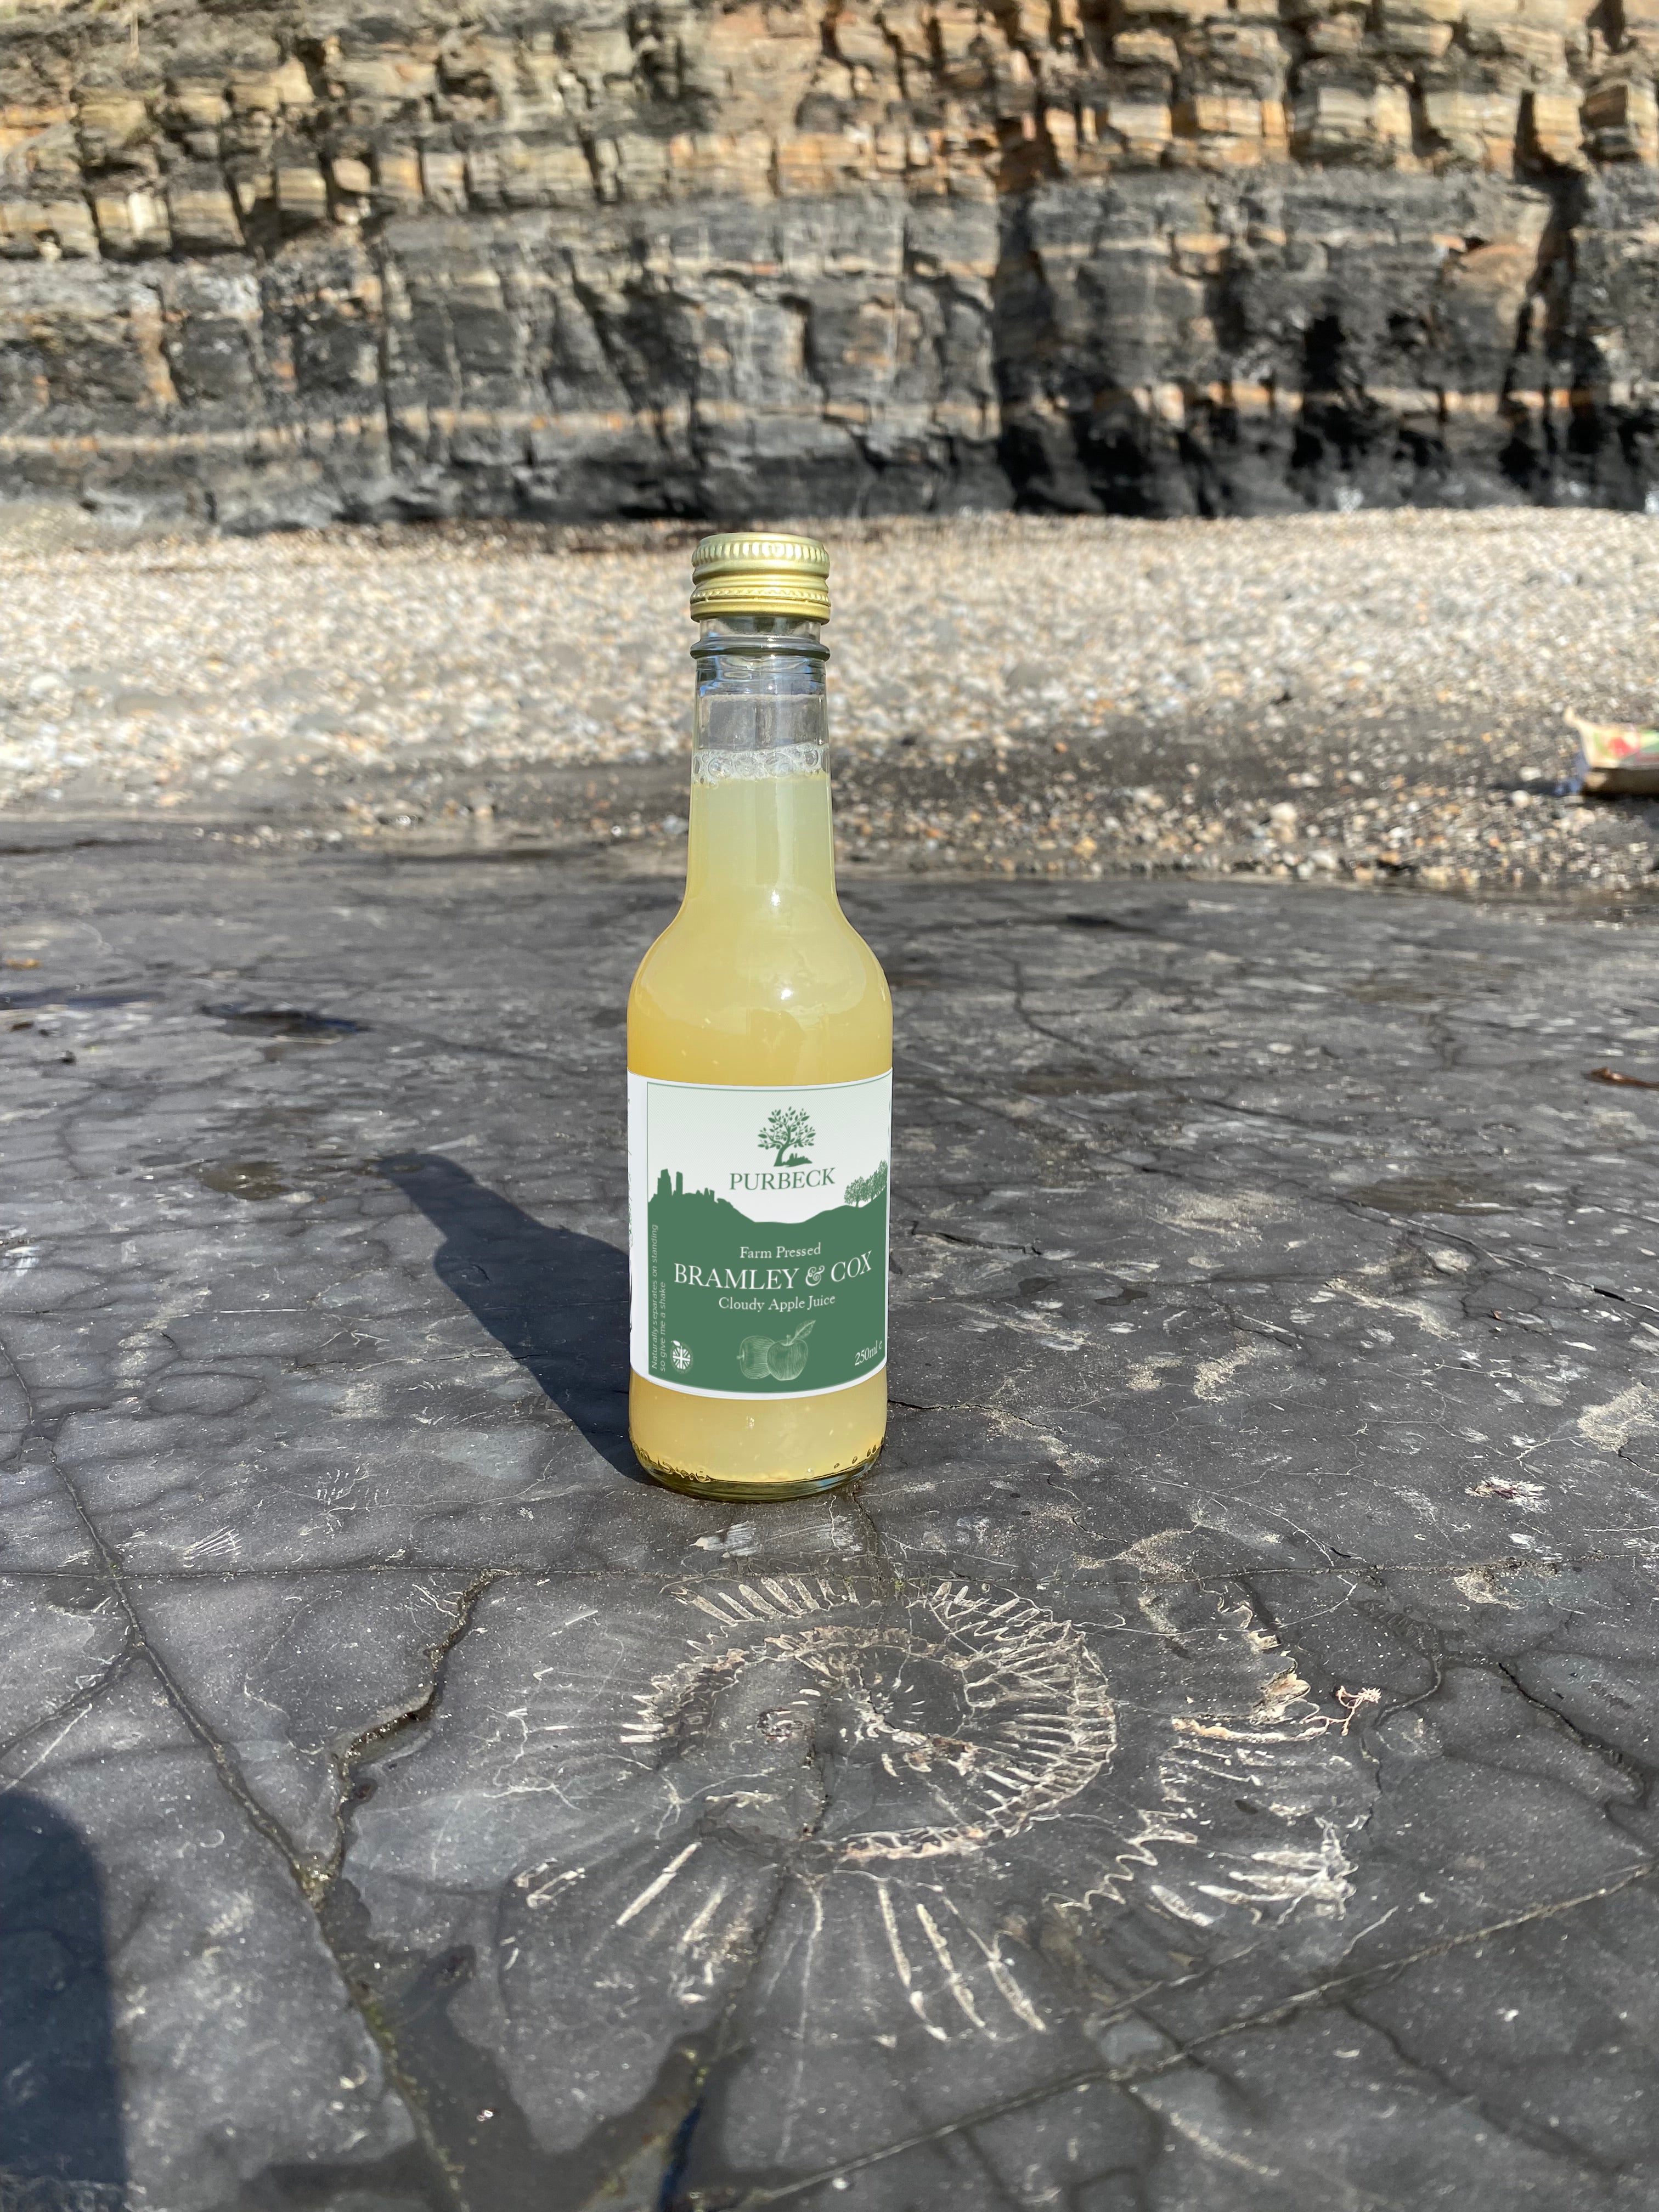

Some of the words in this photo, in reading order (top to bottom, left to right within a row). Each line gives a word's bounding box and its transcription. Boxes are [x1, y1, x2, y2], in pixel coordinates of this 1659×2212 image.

[729, 1167, 836, 1190] PURBECK
[651, 1224, 659, 1263] standing
[740, 1246, 772, 1259] Farm
[776, 1242, 821, 1259] Pressed
[652, 1266, 657, 1277] on
[674, 1262, 799, 1290] BRAMLEY
[805, 1265, 825, 1287] &
[831, 1250, 872, 1282] COX
[718, 1296, 765, 1313] Cloudy
[768, 1296, 805, 1313] Apple
[806, 1294, 836, 1311] Juice
[660, 1321, 666, 1335] me
[651, 1326, 659, 1369] Naturally
[659, 1337, 667, 1358] give
[854, 1339, 878, 1366] 250ml
[660, 1360, 665, 1372] so
